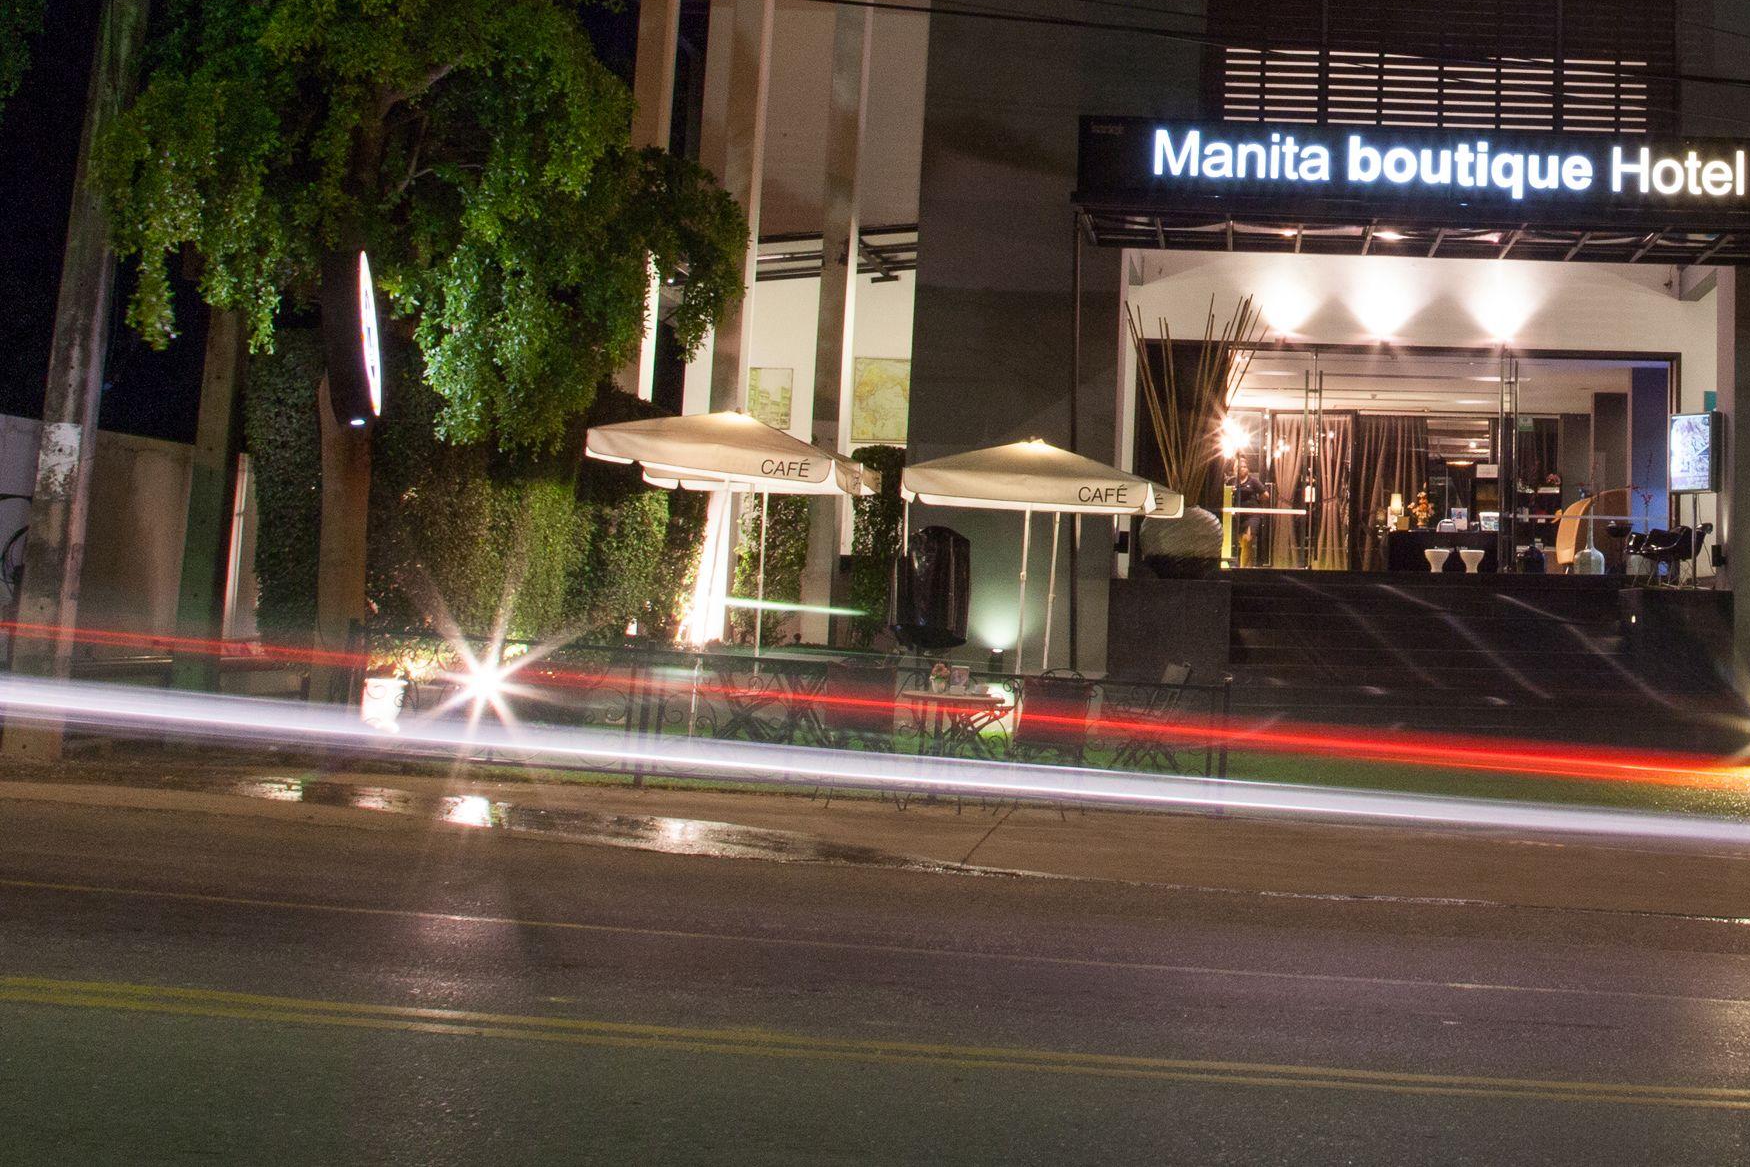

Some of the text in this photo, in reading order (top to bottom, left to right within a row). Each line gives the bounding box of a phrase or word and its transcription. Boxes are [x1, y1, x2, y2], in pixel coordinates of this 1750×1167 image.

[1152, 128, 1746, 200] Manita boutique Hotel
[761, 458, 811, 479] CAFÉ
[1078, 483, 1128, 504] CAFÉ
